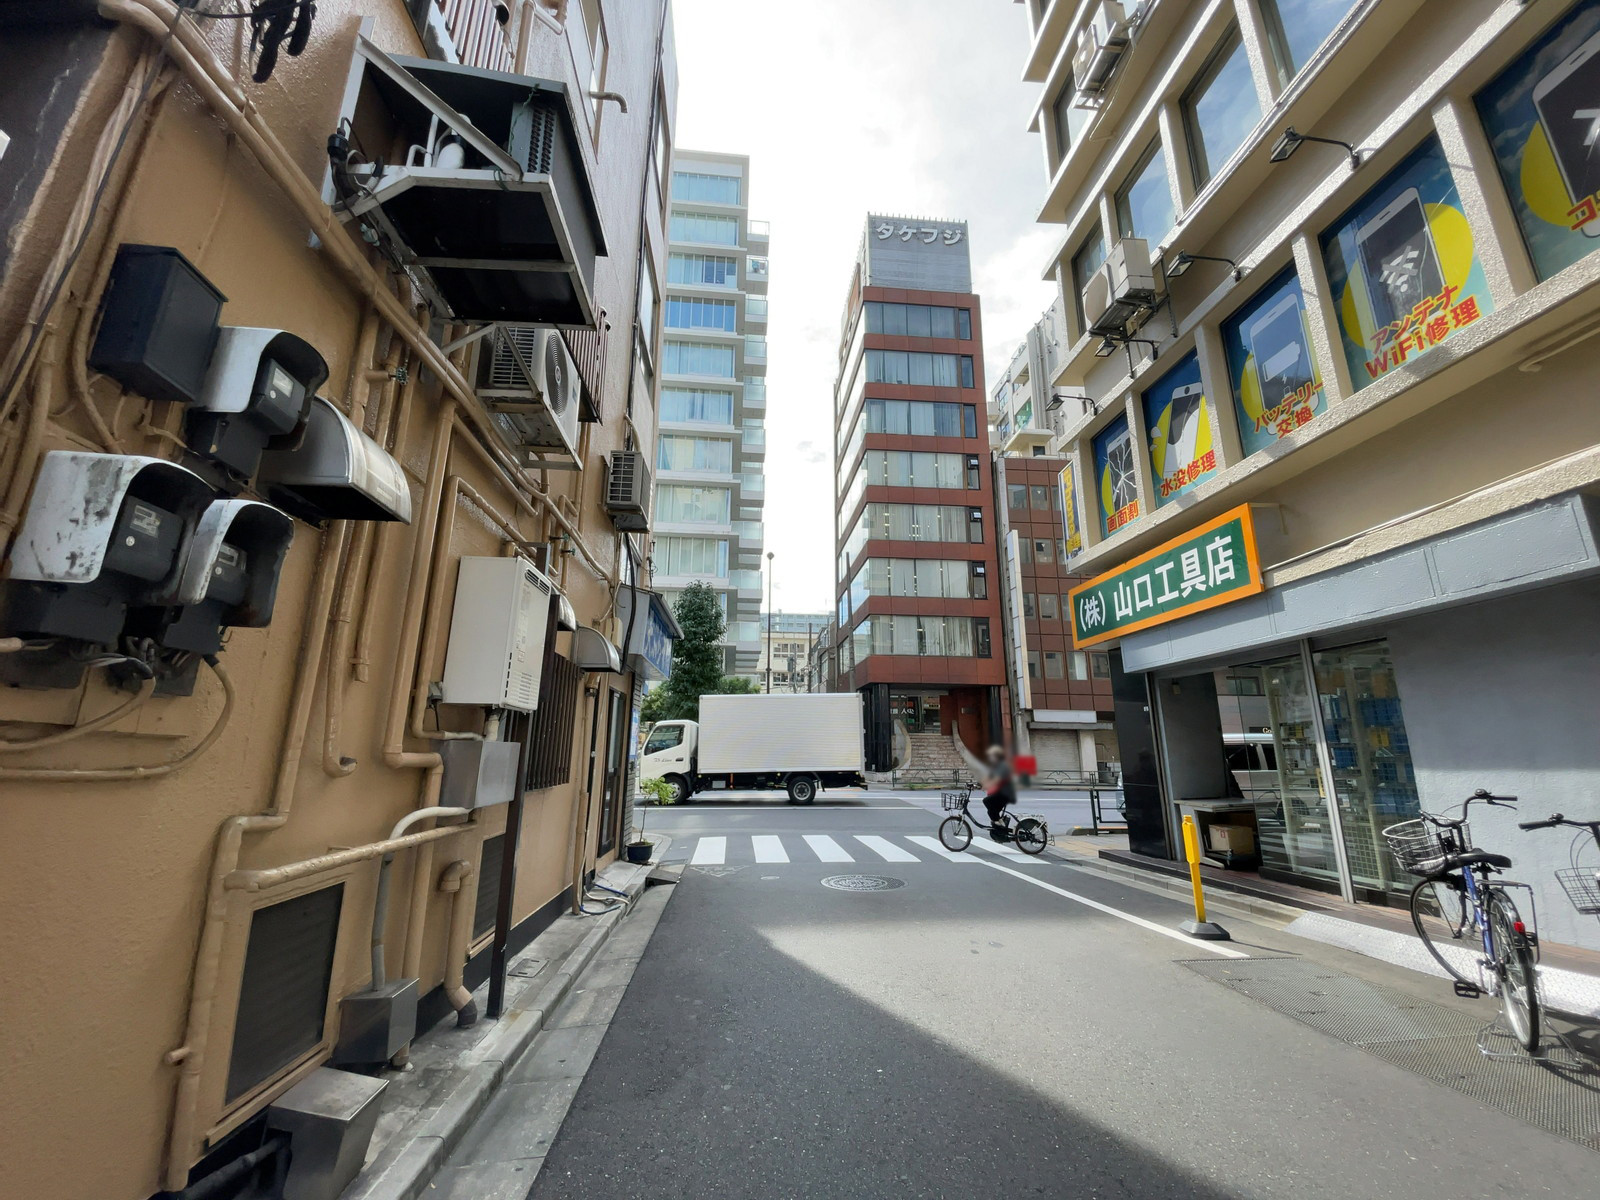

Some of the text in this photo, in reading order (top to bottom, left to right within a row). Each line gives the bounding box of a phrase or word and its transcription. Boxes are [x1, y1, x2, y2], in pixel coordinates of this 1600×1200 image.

[876, 223, 963, 245] タケフジ
[1365, 296, 1480, 378] WiFi修理
[1370, 285, 1458, 355] アンテナ
[1255, 382, 1323, 432] バッテリー
[1277, 406, 1313, 439] 交換
[1160, 449, 1216, 498] 水没修理
